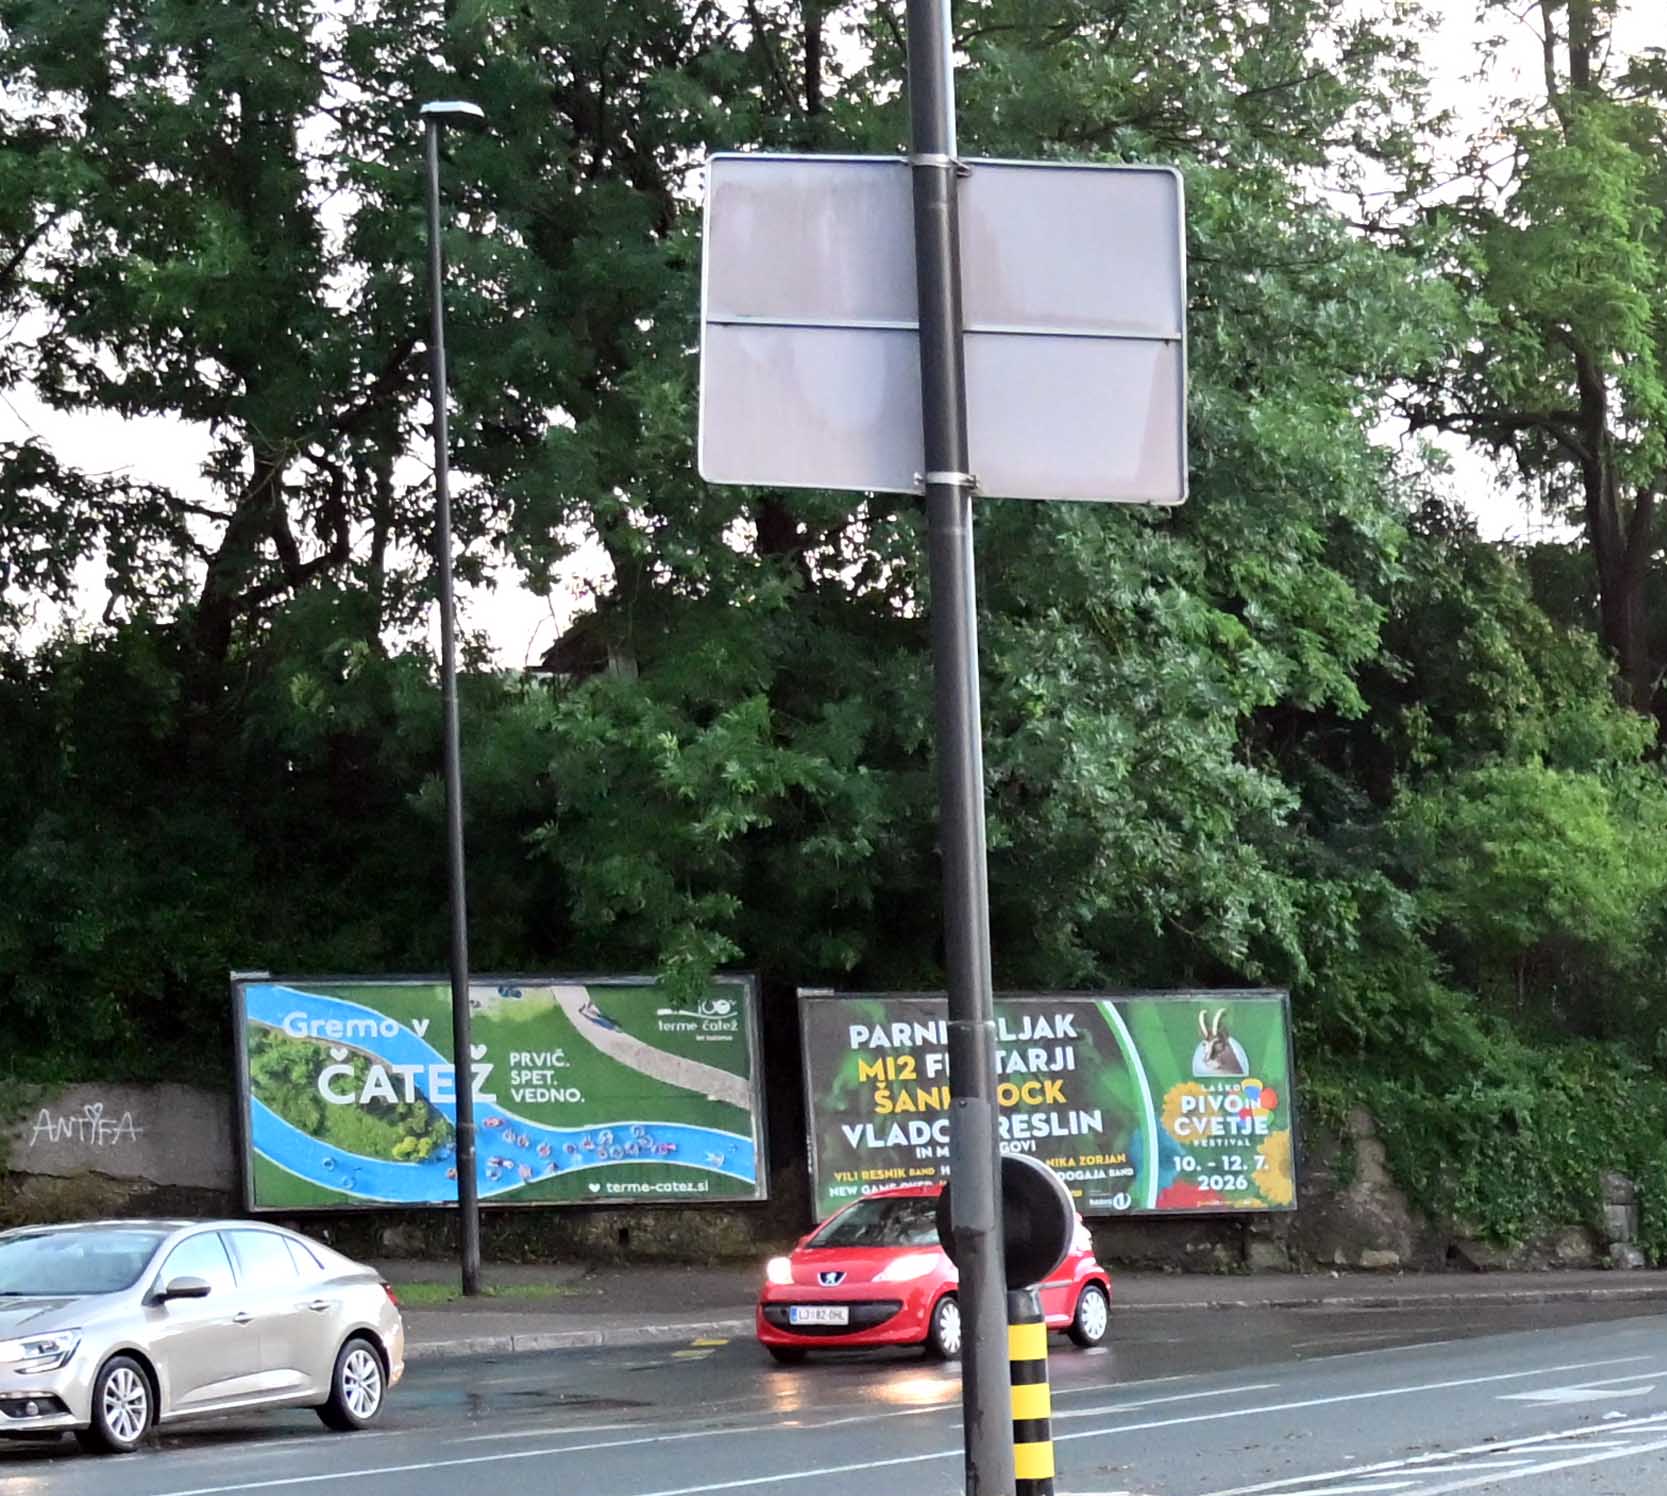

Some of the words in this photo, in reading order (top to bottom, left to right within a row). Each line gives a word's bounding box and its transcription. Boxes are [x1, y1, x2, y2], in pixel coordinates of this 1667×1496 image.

[282, 1011, 401, 1039] Gremo
[412, 1018, 430, 1037] v
[657, 1020, 698, 1031] terme
[849, 1020, 949, 1049] PARNI
[994, 1013, 1078, 1042] LJAK
[509, 1048, 571, 1068] PRVIČ.
[317, 1044, 497, 1104] ČATEŽ
[509, 1069, 558, 1085] SPET.
[858, 1055, 918, 1083] MI2
[510, 1087, 586, 1104] VEDNO.
[996, 1079, 1068, 1108] OCK
[1181, 1094, 1243, 1114] PIVO
[997, 1110, 1104, 1140] RESLIN
[1174, 1115, 1269, 1136] CVETJE
[1193, 1138, 1252, 1148] FESTIVAL
[916, 1146, 933, 1160] IN
[1079, 1153, 1127, 1167] ZORJAN
[1173, 1156, 1202, 1172] 10.
[1222, 1155, 1248, 1171] 12.
[1253, 1155, 1269, 1170] 7.
[834, 1171, 859, 1182] VILI
[861, 1168, 906, 1181] RESNIK
[1197, 1175, 1249, 1191] 2026
[606, 1179, 709, 1193] terme-catez.si
[828, 1185, 859, 1198] NEW
